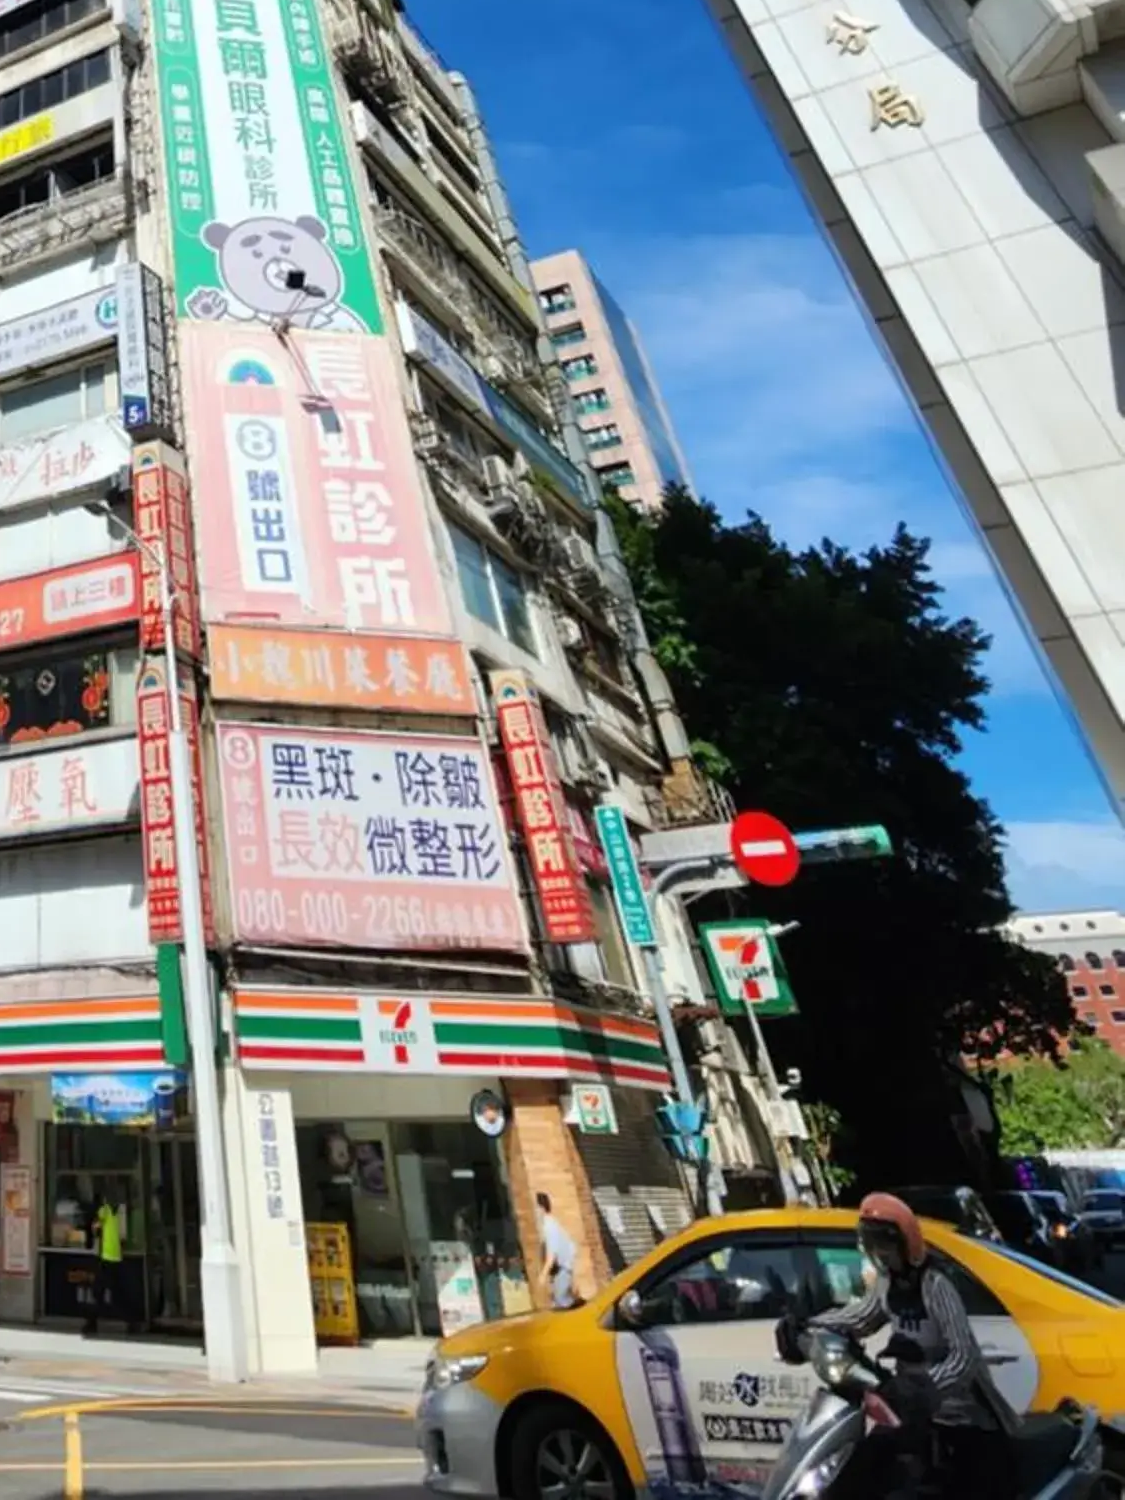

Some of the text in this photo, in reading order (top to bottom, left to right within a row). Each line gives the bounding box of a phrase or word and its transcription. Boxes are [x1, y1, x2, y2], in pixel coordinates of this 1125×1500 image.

[305, 342, 419, 631] 長虹診所
[141, 702, 177, 867] 長虹診所
[274, 810, 503, 882] 長效微整形
[502, 705, 566, 873] 長虹診所
